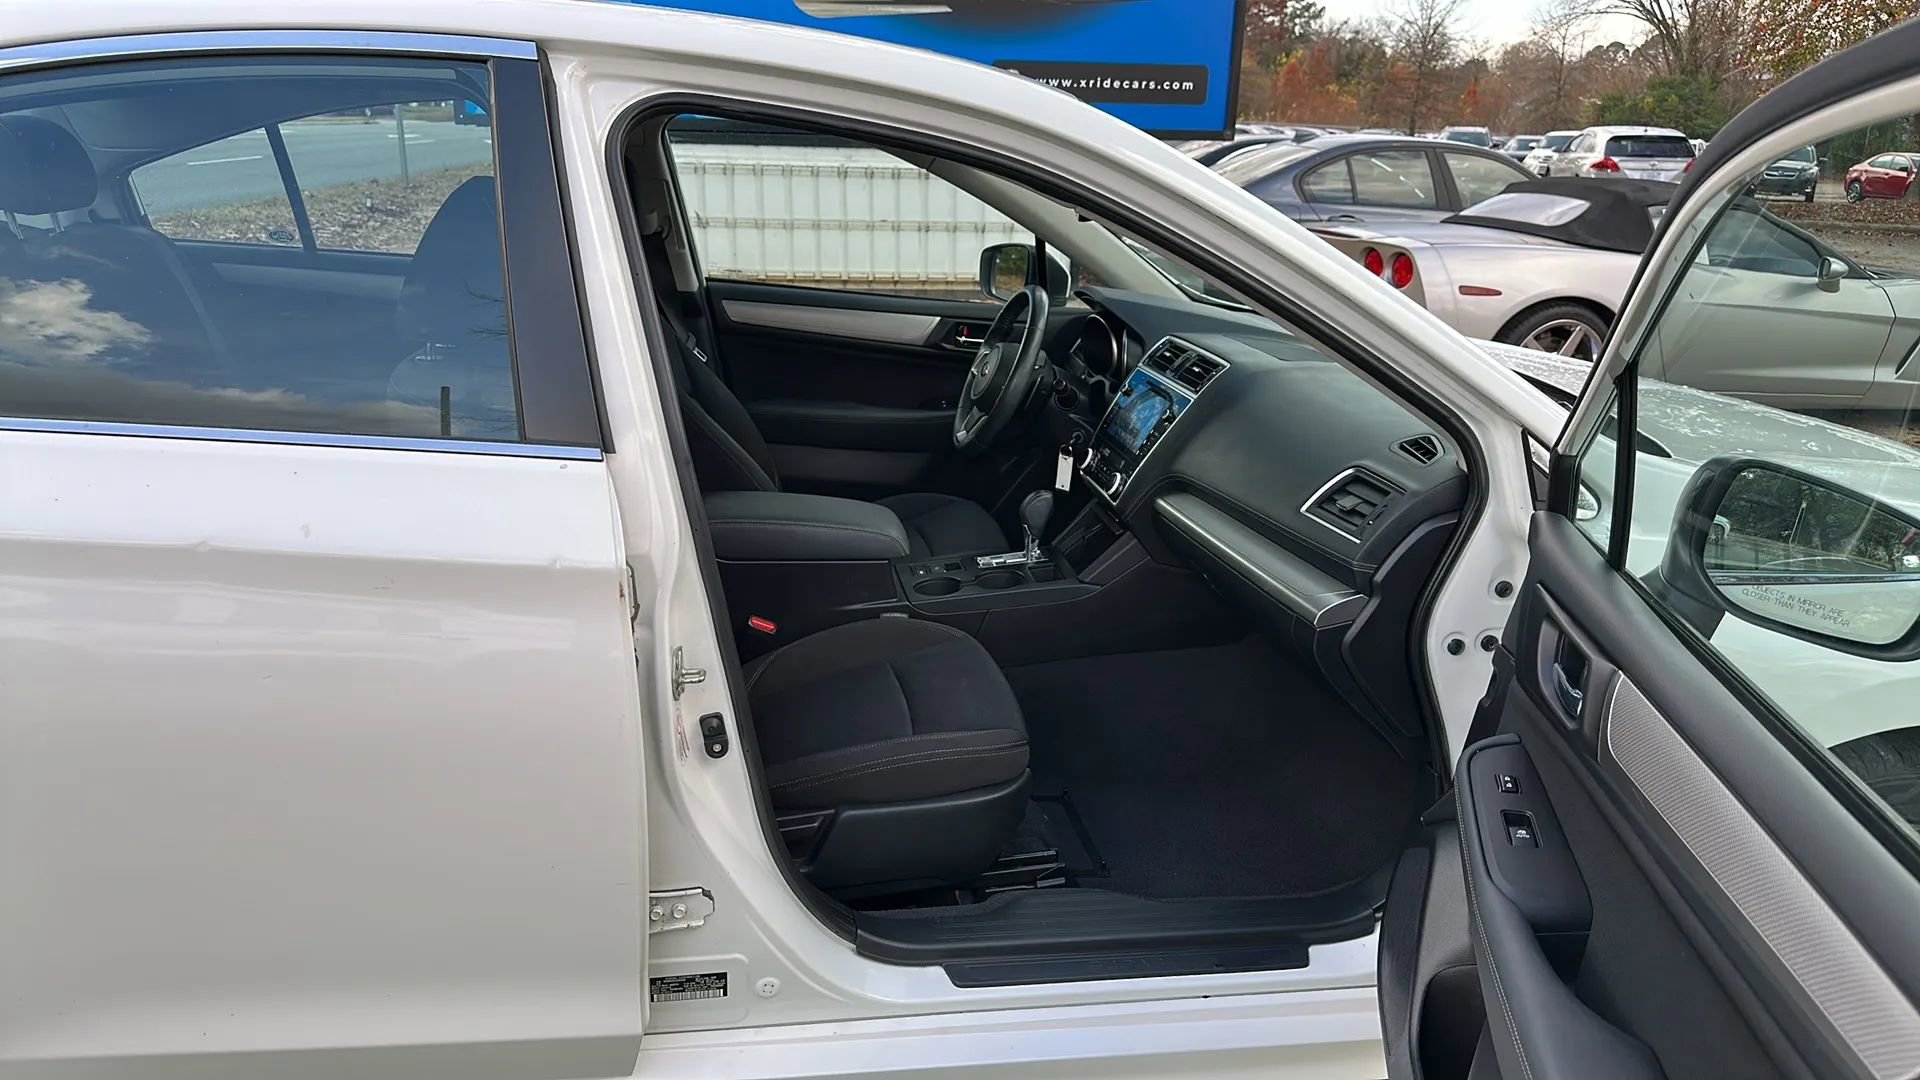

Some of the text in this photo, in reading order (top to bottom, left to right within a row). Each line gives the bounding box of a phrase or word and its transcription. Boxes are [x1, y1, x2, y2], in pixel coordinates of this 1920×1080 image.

[1742, 588, 1850, 627] CLOSER THAN THEY APPEAR
[1787, 594, 1796, 603] IN
[1797, 597, 1826, 612] MIRROR
[1829, 607, 1845, 618] ARE
